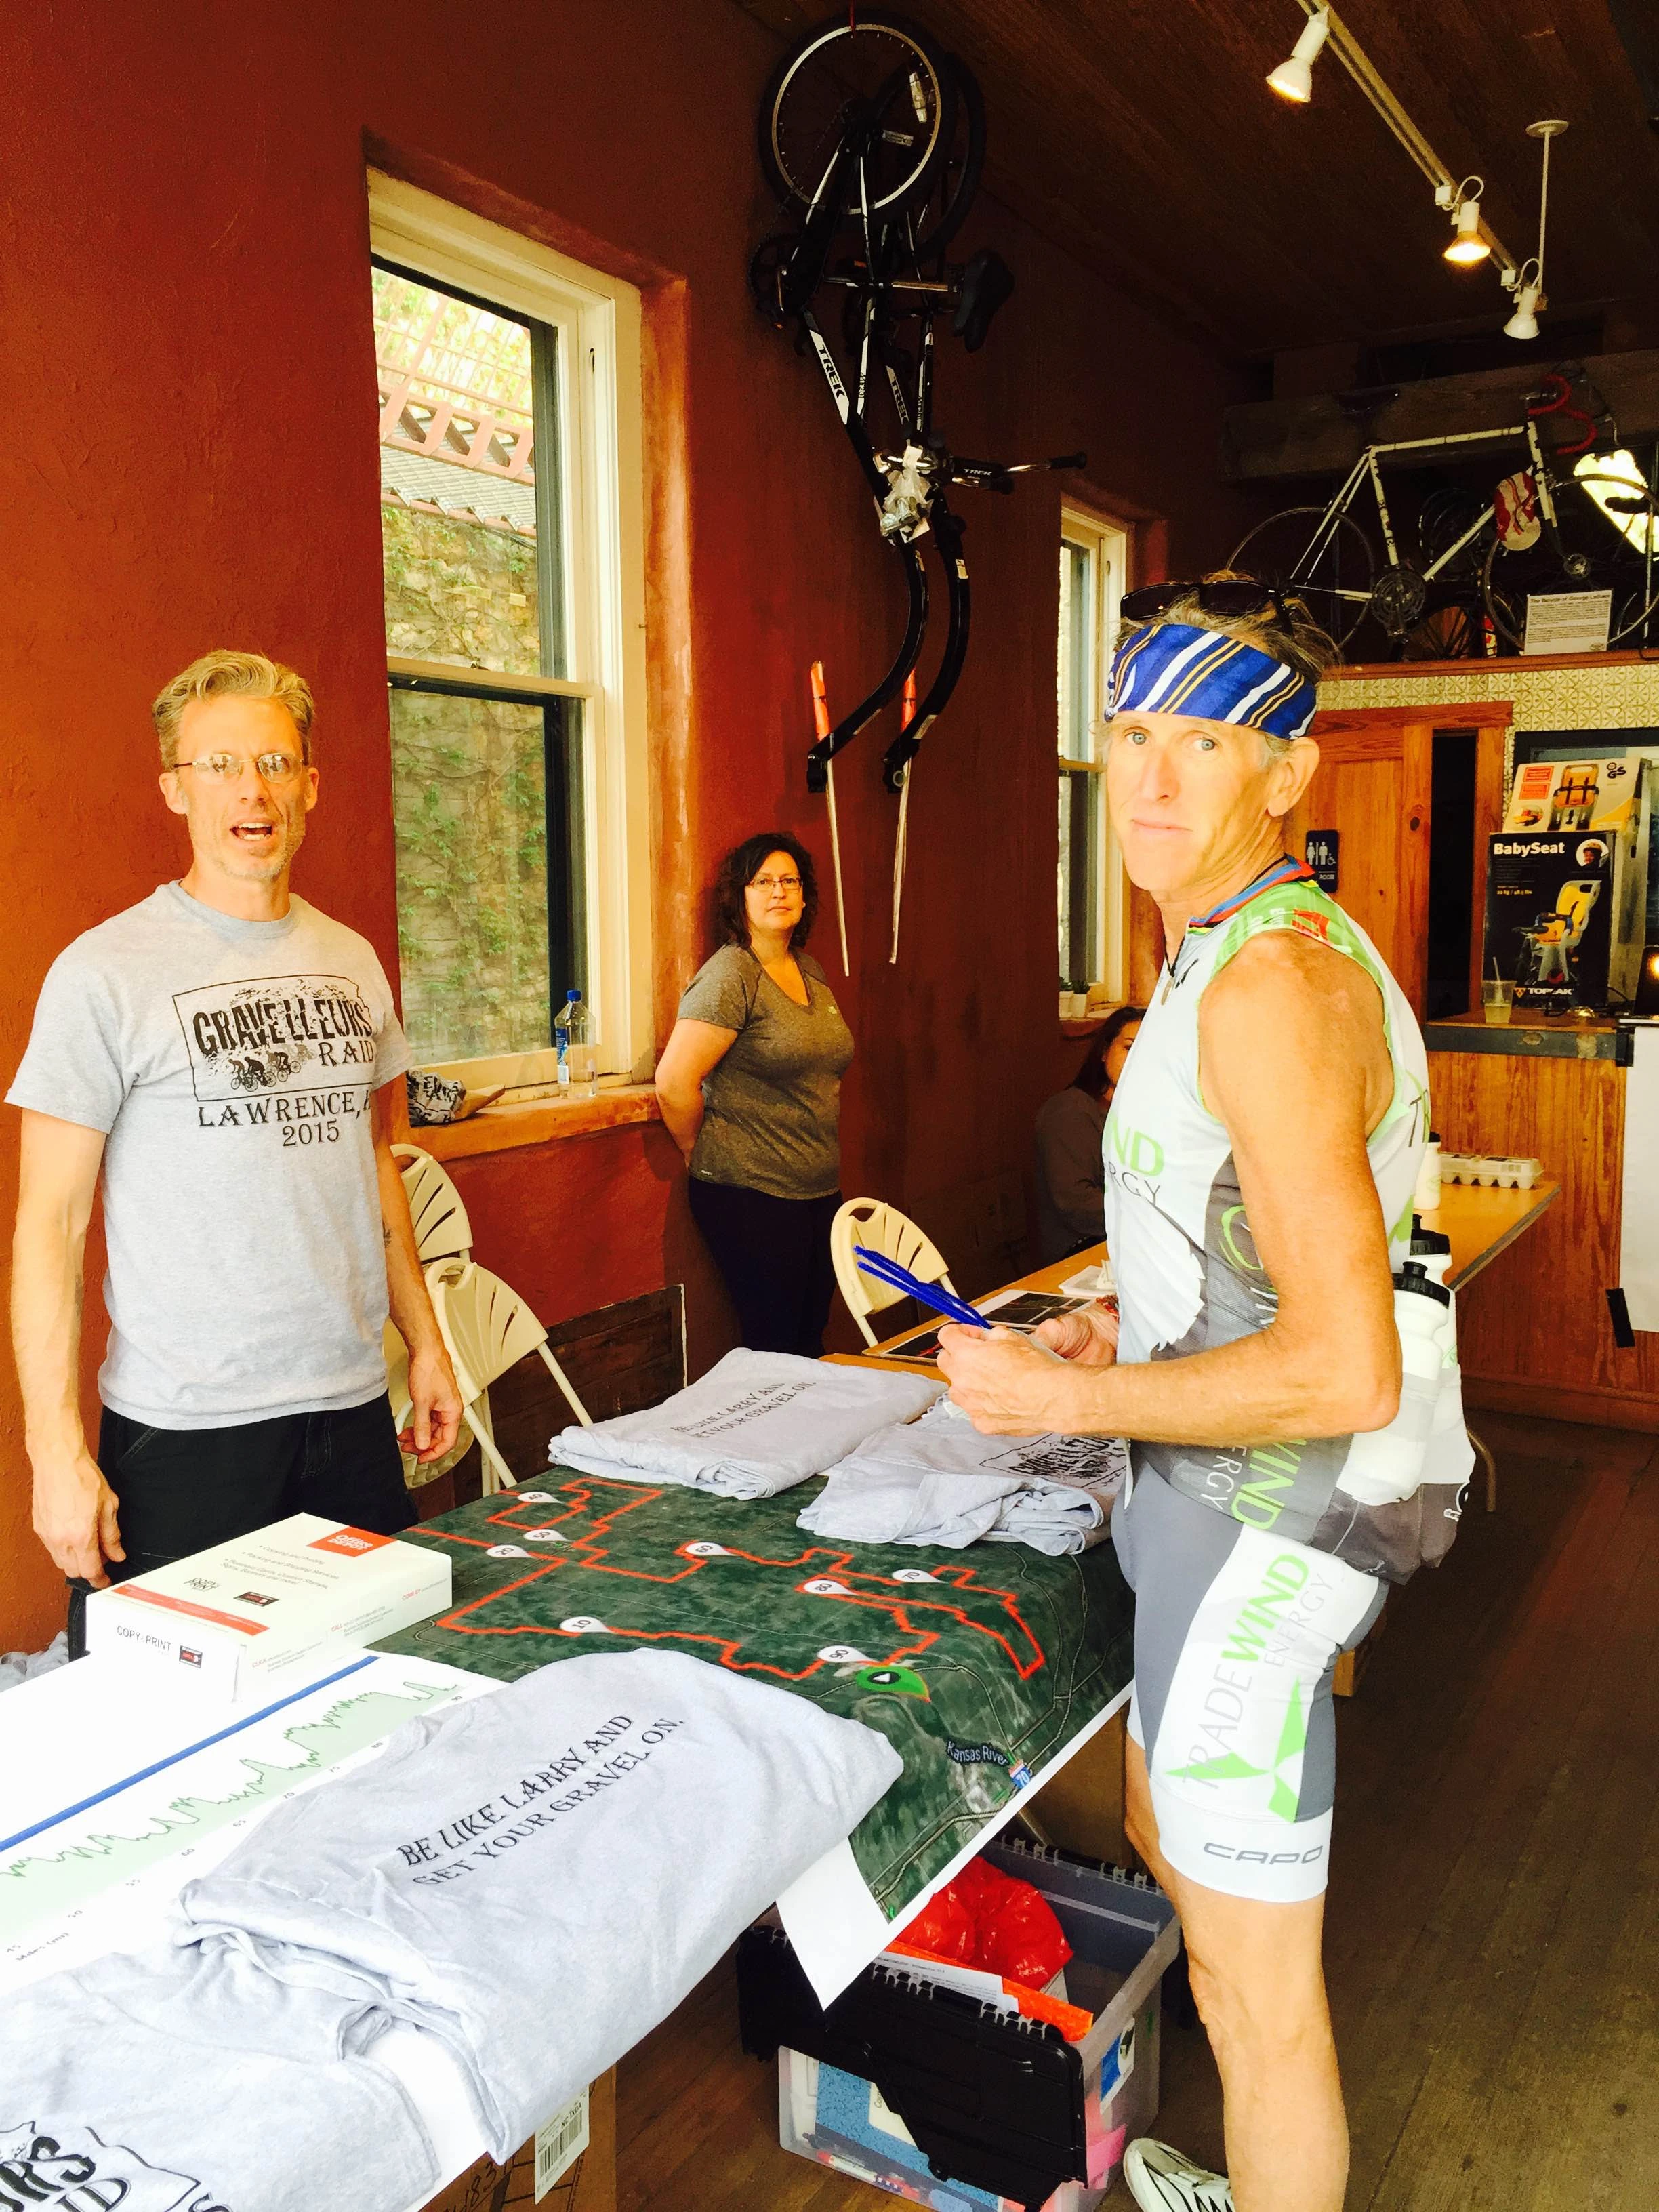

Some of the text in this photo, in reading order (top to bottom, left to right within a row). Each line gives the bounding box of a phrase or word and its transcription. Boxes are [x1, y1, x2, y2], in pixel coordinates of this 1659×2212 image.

[819, 344, 845, 398] TREK
[1607, 766, 1626, 779] GS
[1494, 842, 1565, 857] BabySeat
[192, 998, 373, 1057] GRAVELLEURS
[318, 1040, 374, 1067] RAID
[197, 1090, 361, 1127] LAWRENCE,
[282, 1120, 340, 1147] 2015
[533, 1531, 552, 1539] 50
[495, 1547, 514, 1555] 20
[696, 1544, 714, 1553] 60
[817, 1582, 832, 1592] 80
[903, 1571, 920, 1581] 70
[1221, 1553, 1309, 1662] WIND
[572, 1619, 592, 1629] 10
[1264, 1575, 1337, 1667] ENERGY
[117, 1626, 171, 1651] COPY PRINT
[832, 1648, 850, 1660] 90
[1181, 1663, 1254, 1790] TRADE
[947, 1740, 1008, 1765] Kansas River
[396, 1715, 634, 1866] BE LIKE LARRY AND
[1016, 1769, 1031, 1788] 70
[412, 1717, 686, 1885] GET YOUR GRAVEL ON.
[180, 1847, 195, 1857] 60
[1203, 1842, 1324, 1865] CAPO
